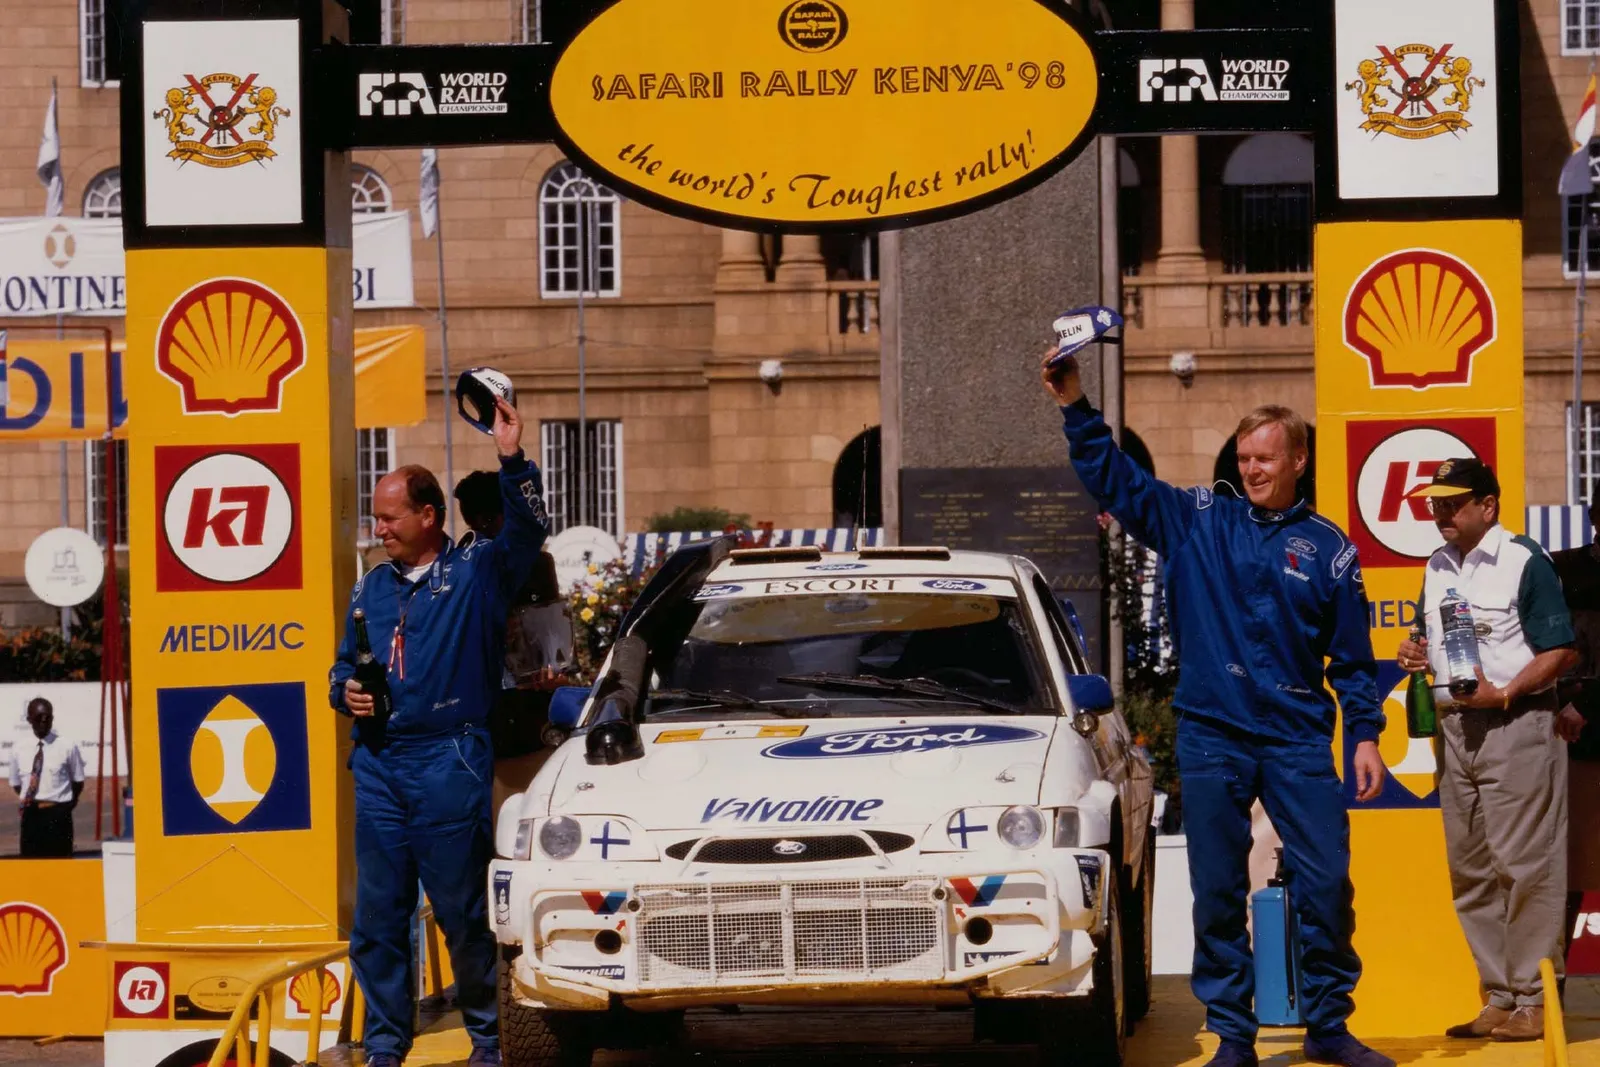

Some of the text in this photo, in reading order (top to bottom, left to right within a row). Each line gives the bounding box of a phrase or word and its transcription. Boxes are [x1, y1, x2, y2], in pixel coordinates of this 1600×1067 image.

[794, 11, 831, 19] SAFARI
[797, 31, 829, 39] RALLY
[1399, 45, 1430, 54] KENYA
[1221, 59, 1290, 74] WORLD
[206, 75, 237, 83] KENYA
[439, 72, 508, 87] WORLD
[591, 71, 723, 101] SAFARI
[740, 68, 858, 98] RALLY
[1221, 73, 1288, 90] RALLY
[440, 86, 505, 103] RALLY
[1221, 91, 1289, 100] CHAMPIONSHIP
[439, 103, 507, 113] CHAMPIONSHIP
[617, 128, 1036, 215] the world's Toughest rally!
[0, 275, 126, 312] ONTINE
[764, 577, 903, 595] ESCORT
[932, 579, 977, 592] Ford
[159, 621, 305, 653] MEDIVAC
[819, 726, 986, 754] Ford
[699, 795, 884, 824] Valvoline
